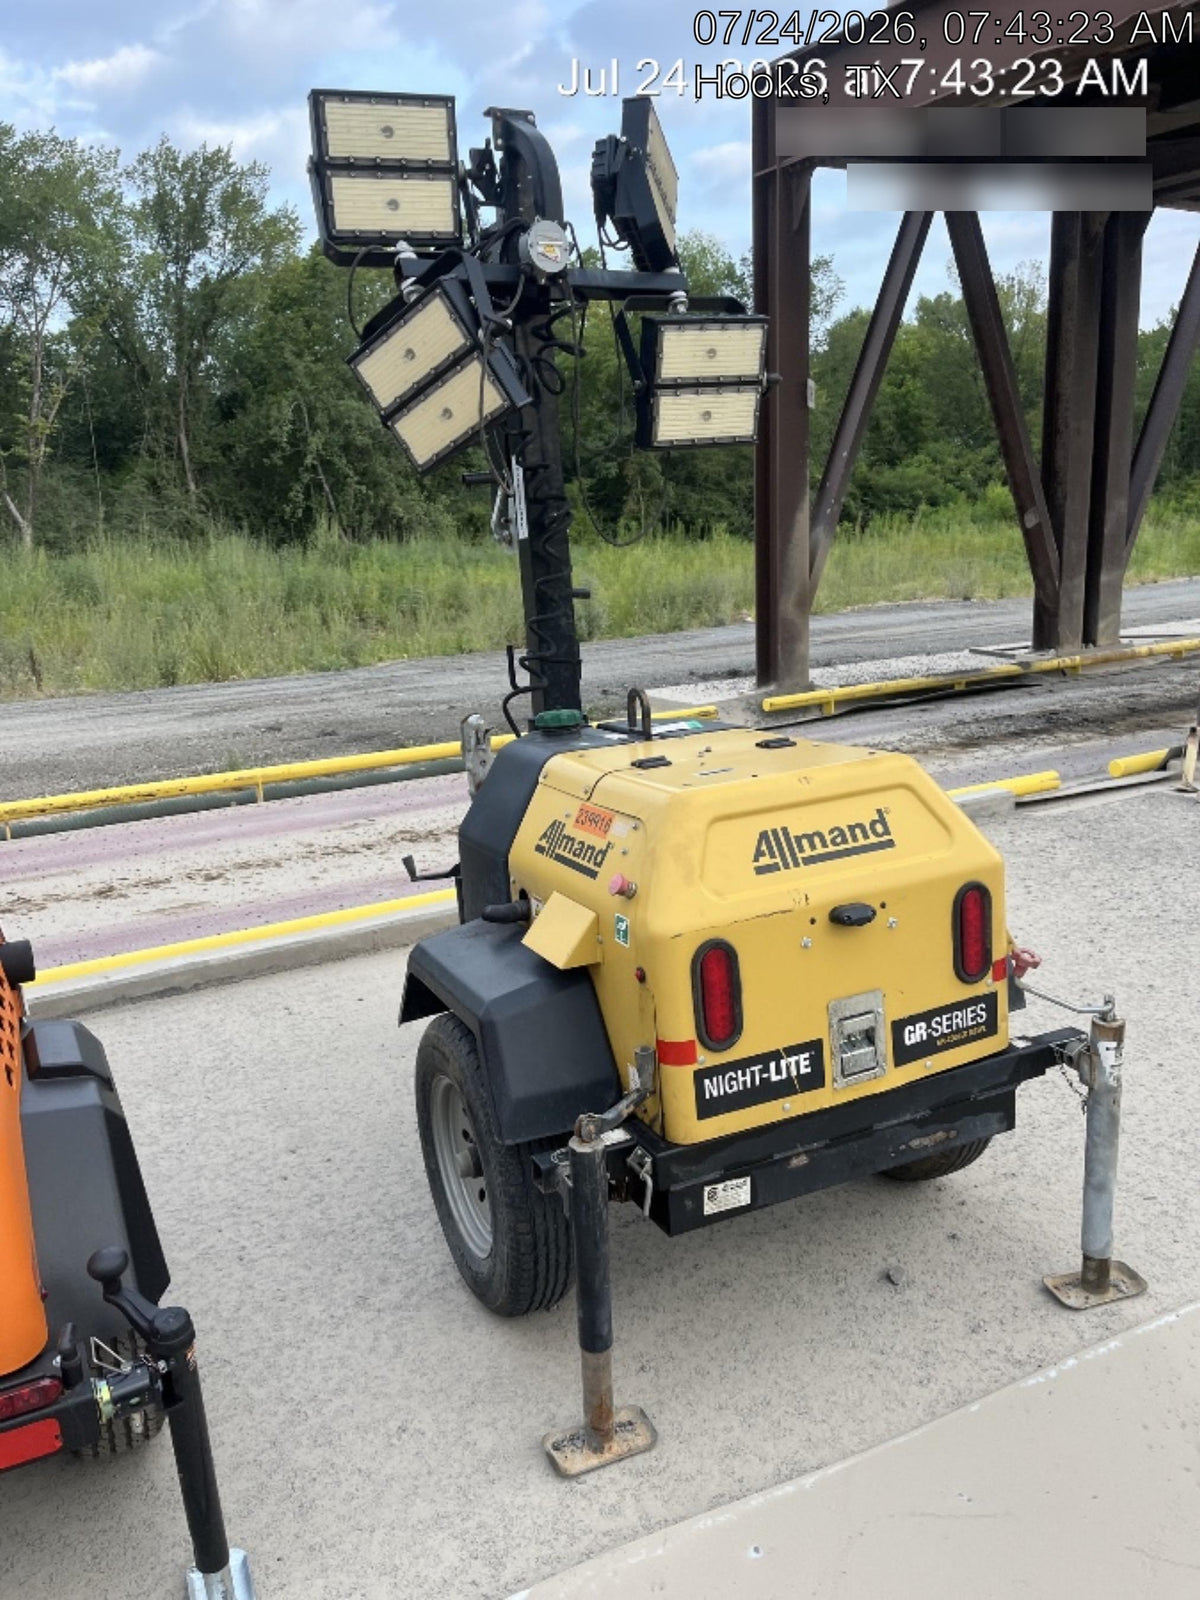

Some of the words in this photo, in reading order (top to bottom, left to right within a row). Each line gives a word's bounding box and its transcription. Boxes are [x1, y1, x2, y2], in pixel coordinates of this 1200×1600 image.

[538, 819, 611, 869] Allmand
[752, 808, 892, 869] Allmand
[904, 1003, 987, 1046] GR-SERIES
[703, 1052, 812, 1100] NIGHT-LITE
